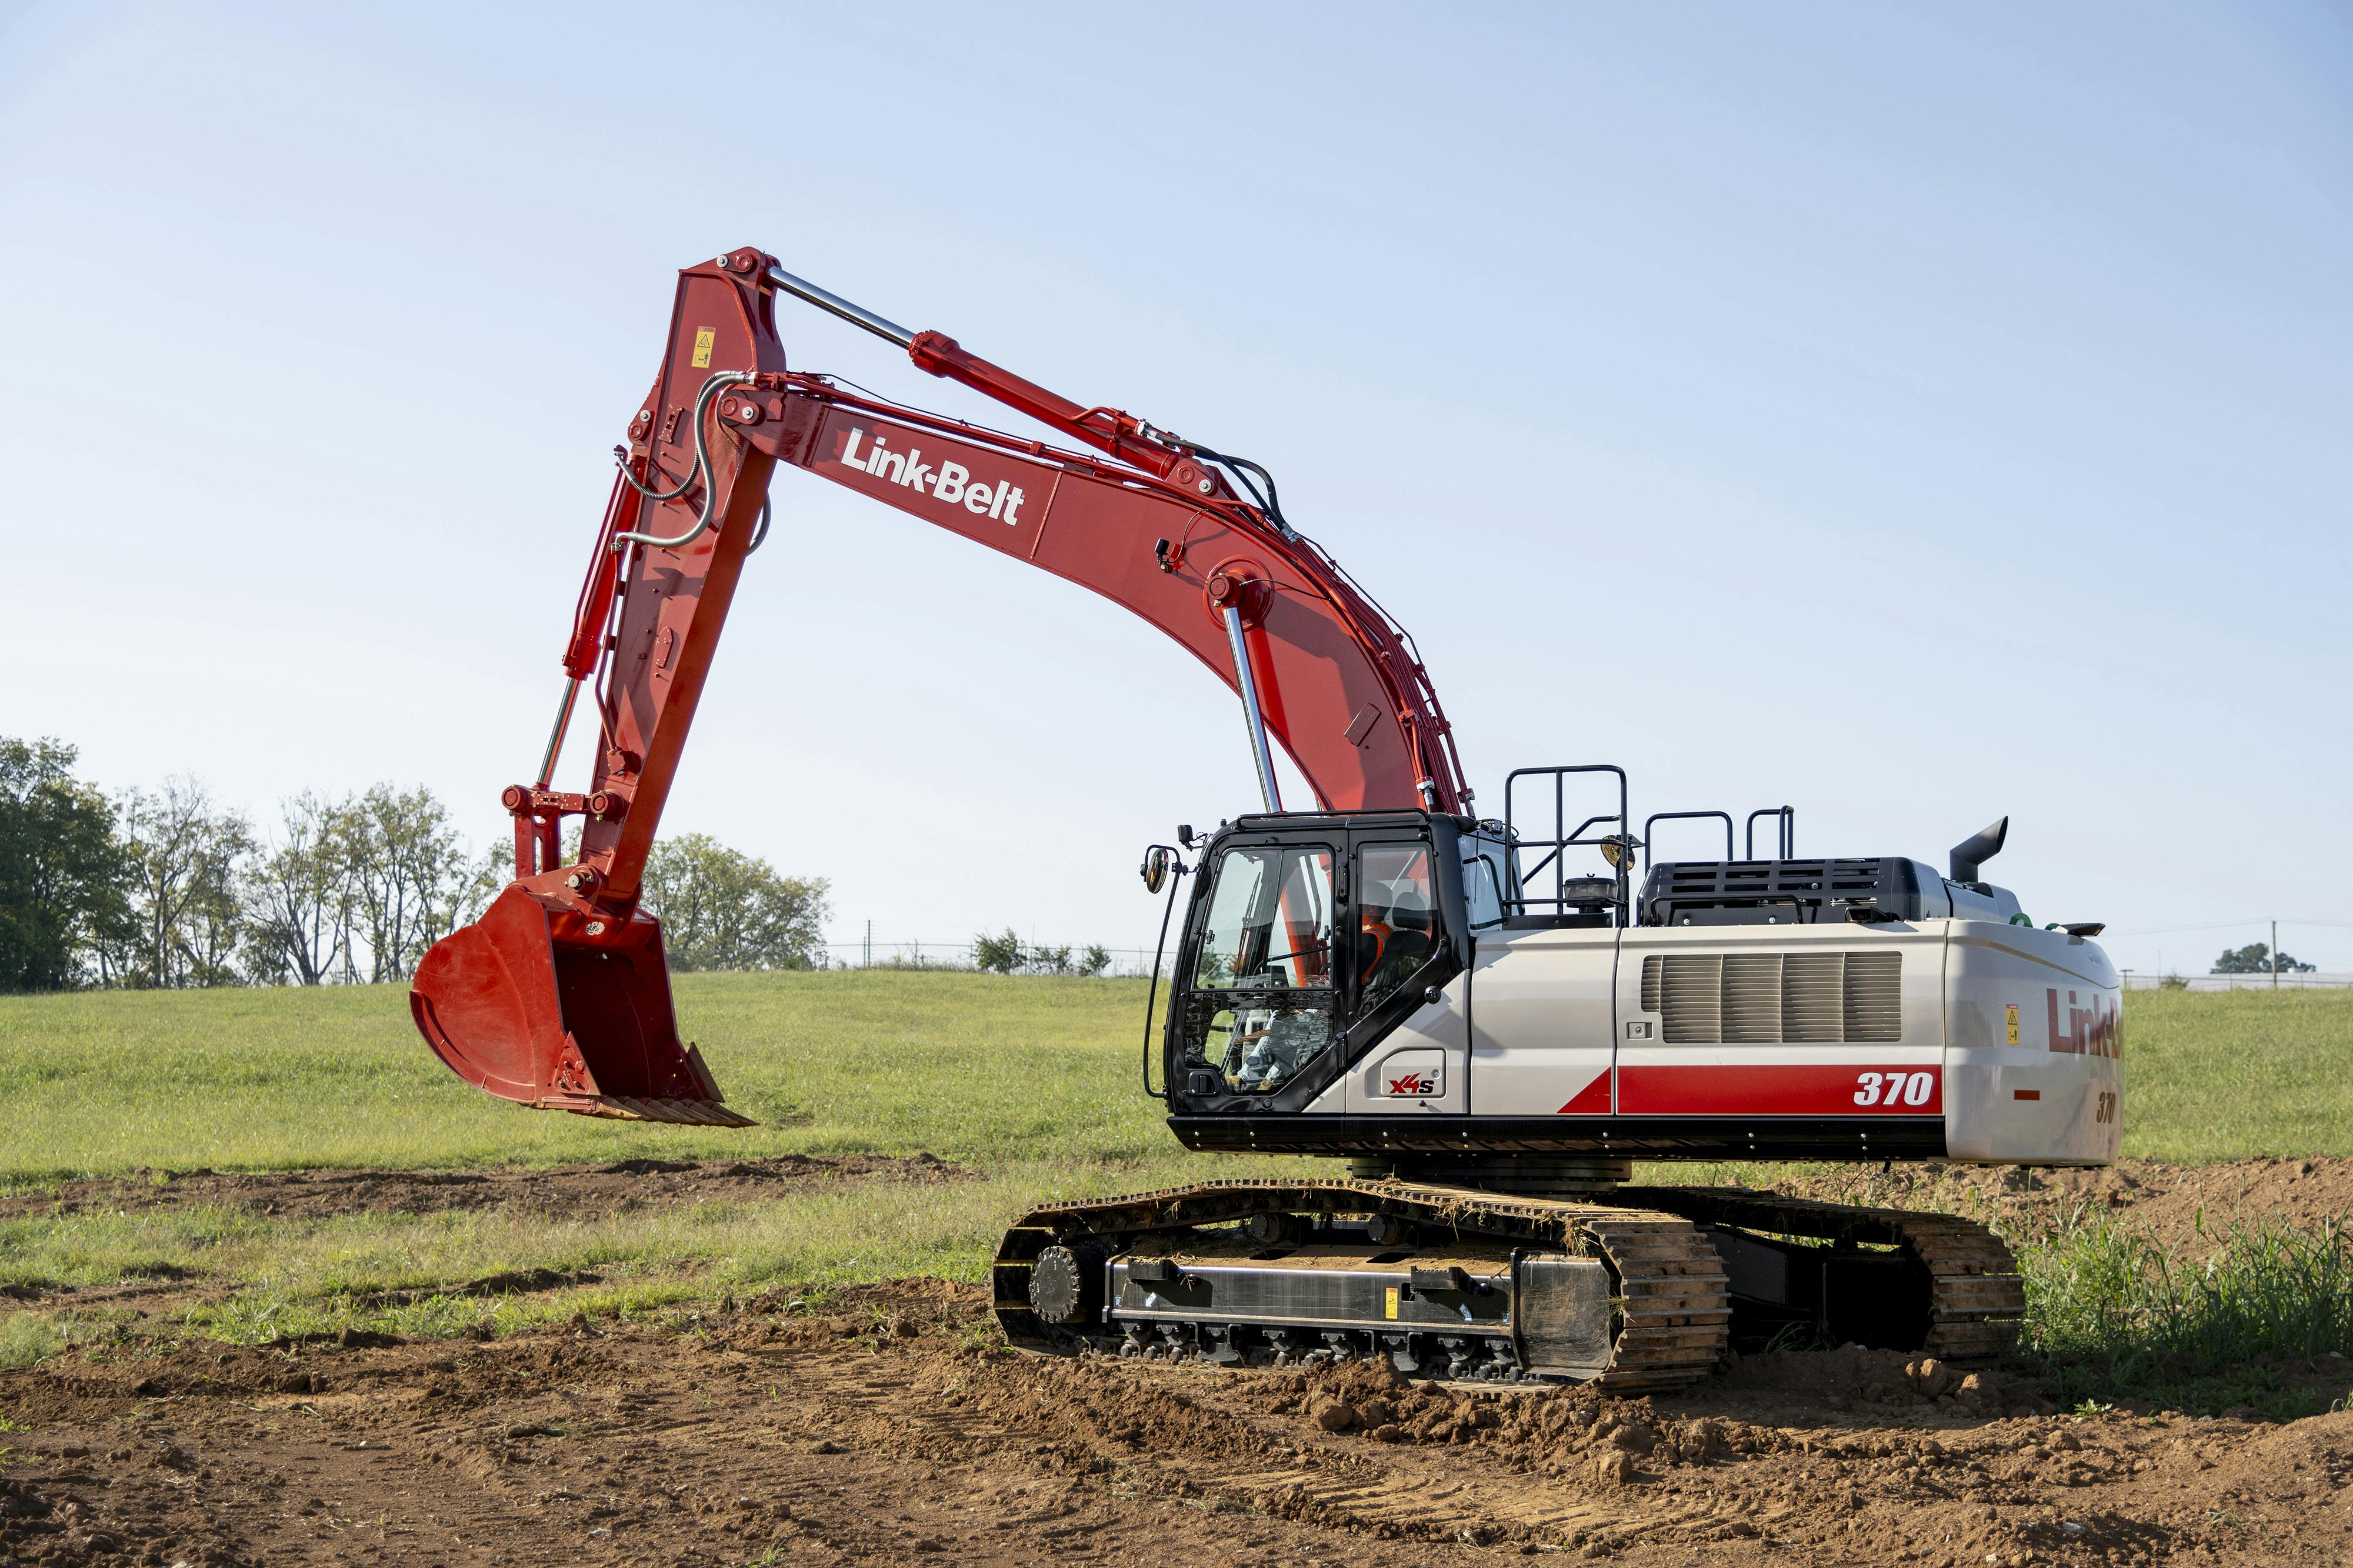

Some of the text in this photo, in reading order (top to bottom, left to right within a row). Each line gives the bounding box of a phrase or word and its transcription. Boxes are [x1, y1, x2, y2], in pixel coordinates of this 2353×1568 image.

[841, 427, 1025, 526] Link-Belt
[1388, 1072, 1434, 1094] X4S
[1854, 1072, 1934, 1106] 370
[2097, 1091, 2116, 1124] 370
